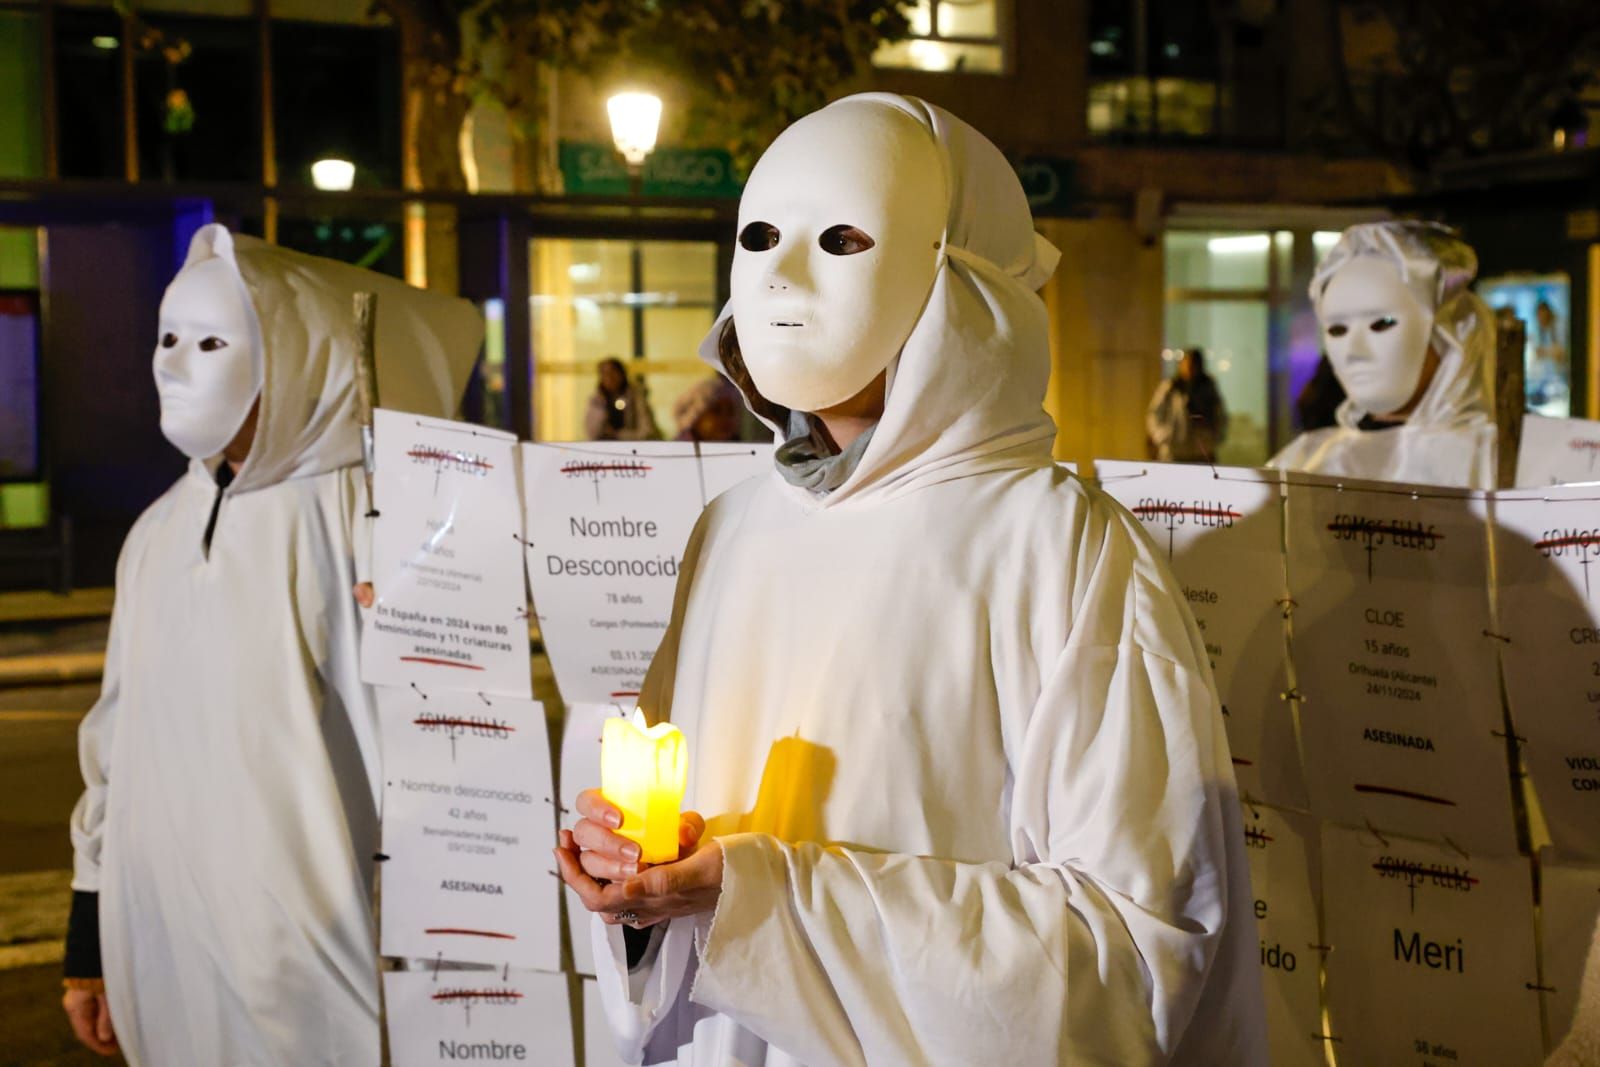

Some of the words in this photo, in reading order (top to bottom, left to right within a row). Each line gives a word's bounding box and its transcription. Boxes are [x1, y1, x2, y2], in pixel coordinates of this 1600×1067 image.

[565, 459, 607, 479] SOMOS
[612, 460, 647, 478] ELLAS
[1138, 497, 1185, 525] SOMOS
[1194, 501, 1233, 528] ELLAS
[569, 516, 658, 537] Nombre
[1334, 514, 1384, 545] SOMOS
[1392, 521, 1437, 551] ELLAS
[621, 594, 643, 604] años
[1181, 583, 1218, 603] leste
[376, 604, 388, 615] En
[391, 607, 428, 623] España
[430, 615, 443, 625] en
[445, 616, 470, 629] 2024
[472, 623, 493, 632] van
[495, 624, 508, 635] 80
[1365, 608, 1406, 628] CLOE
[374, 619, 438, 640] feminicidios
[440, 632, 446, 643] y
[449, 633, 460, 643] 11
[462, 635, 513, 652] criaturas
[414, 645, 472, 661] asesinadas
[1365, 639, 1378, 653] 15
[1381, 642, 1410, 658] años
[419, 712, 465, 735] SOMOS
[470, 716, 509, 740] ELLAS
[1363, 728, 1436, 752] ASESINADA
[401, 779, 451, 795] Nombre
[454, 784, 533, 805] desconocido
[463, 809, 488, 822] años
[1379, 856, 1424, 885] SOMOS
[1431, 863, 1472, 892] ELLAS
[440, 879, 503, 896] ASESINADA
[1393, 928, 1465, 974] Meri
[439, 1040, 527, 1060] Nombre
